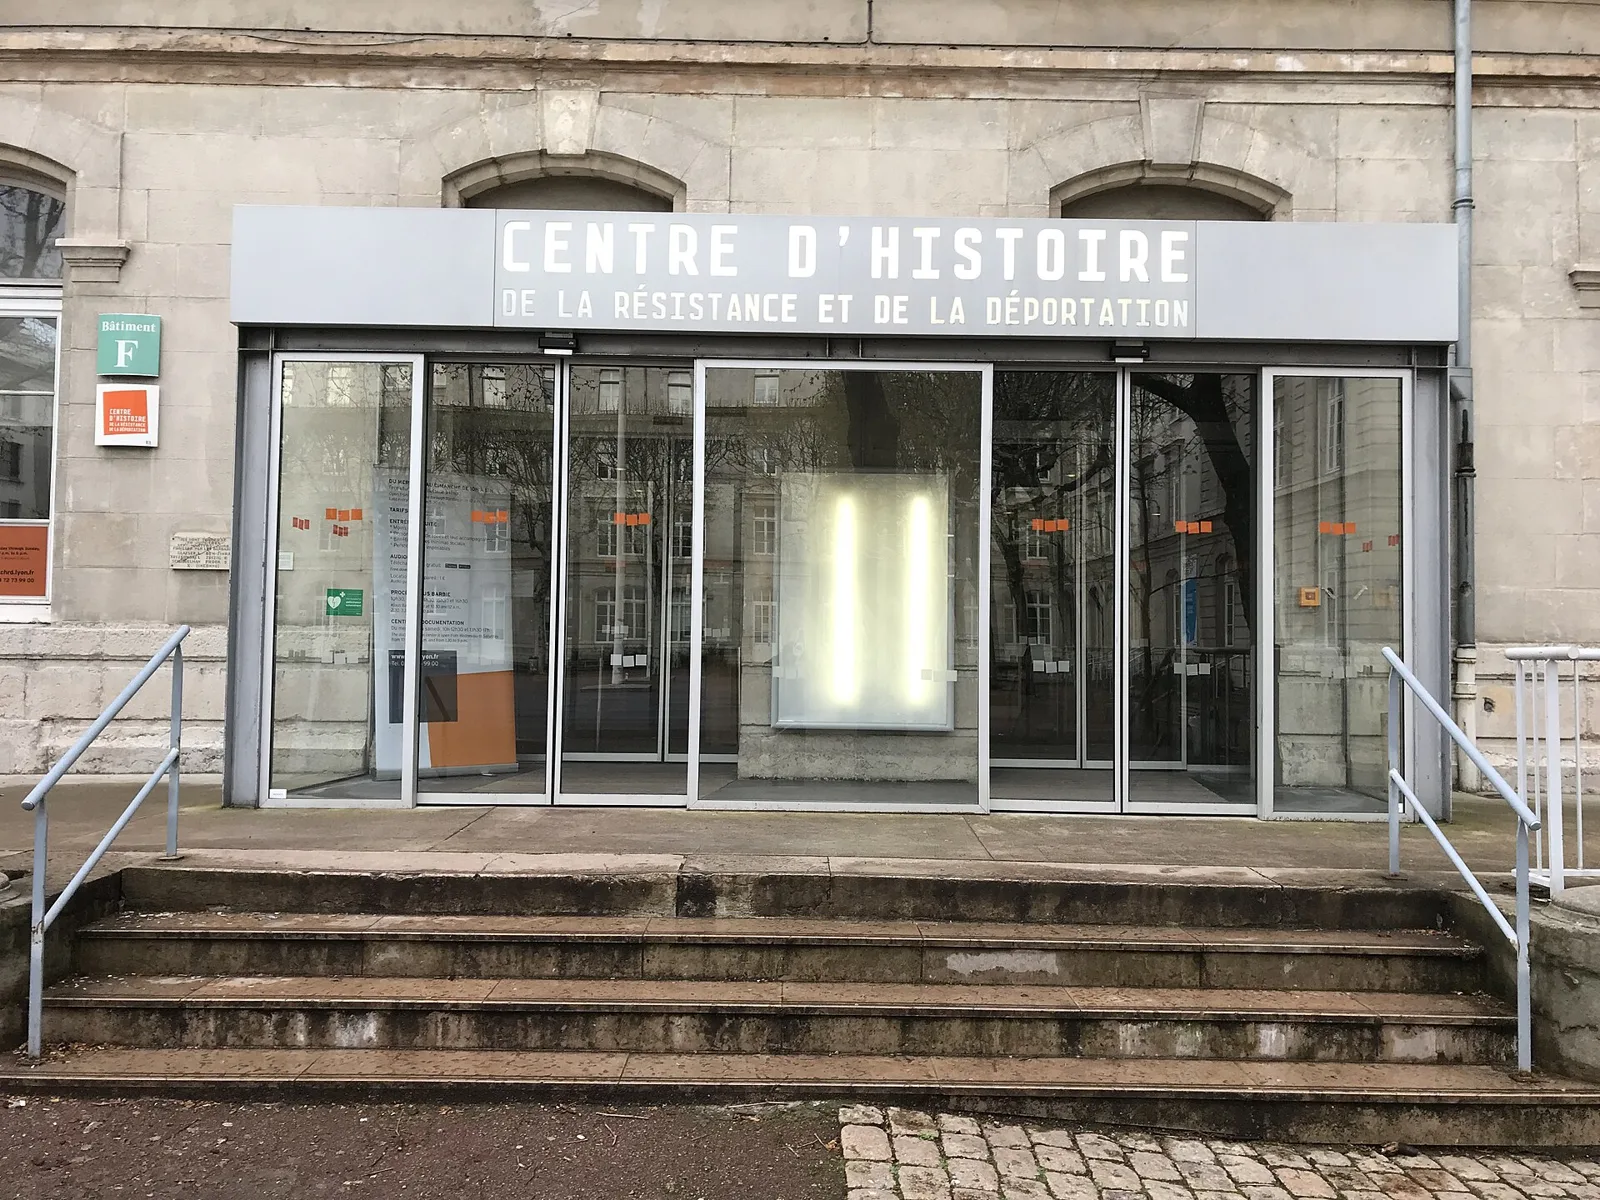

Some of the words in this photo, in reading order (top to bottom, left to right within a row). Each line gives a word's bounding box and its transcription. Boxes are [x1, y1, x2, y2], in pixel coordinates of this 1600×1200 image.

[502, 220, 739, 278] CENTRE
[788, 224, 1190, 284] D'HISTOIRE
[502, 288, 535, 318] DE
[559, 289, 593, 320] LA
[614, 284, 797, 323] RÉSISTANCE
[819, 294, 854, 324] ET
[874, 295, 908, 324] DE
[930, 296, 966, 325] LA
[985, 288, 1189, 328] DÉPORTATION
[101, 320, 157, 333] Bâtiment
[113, 339, 139, 368] F
[109, 408, 132, 416] CENTRE
[109, 415, 147, 423] D'HISTOIRE
